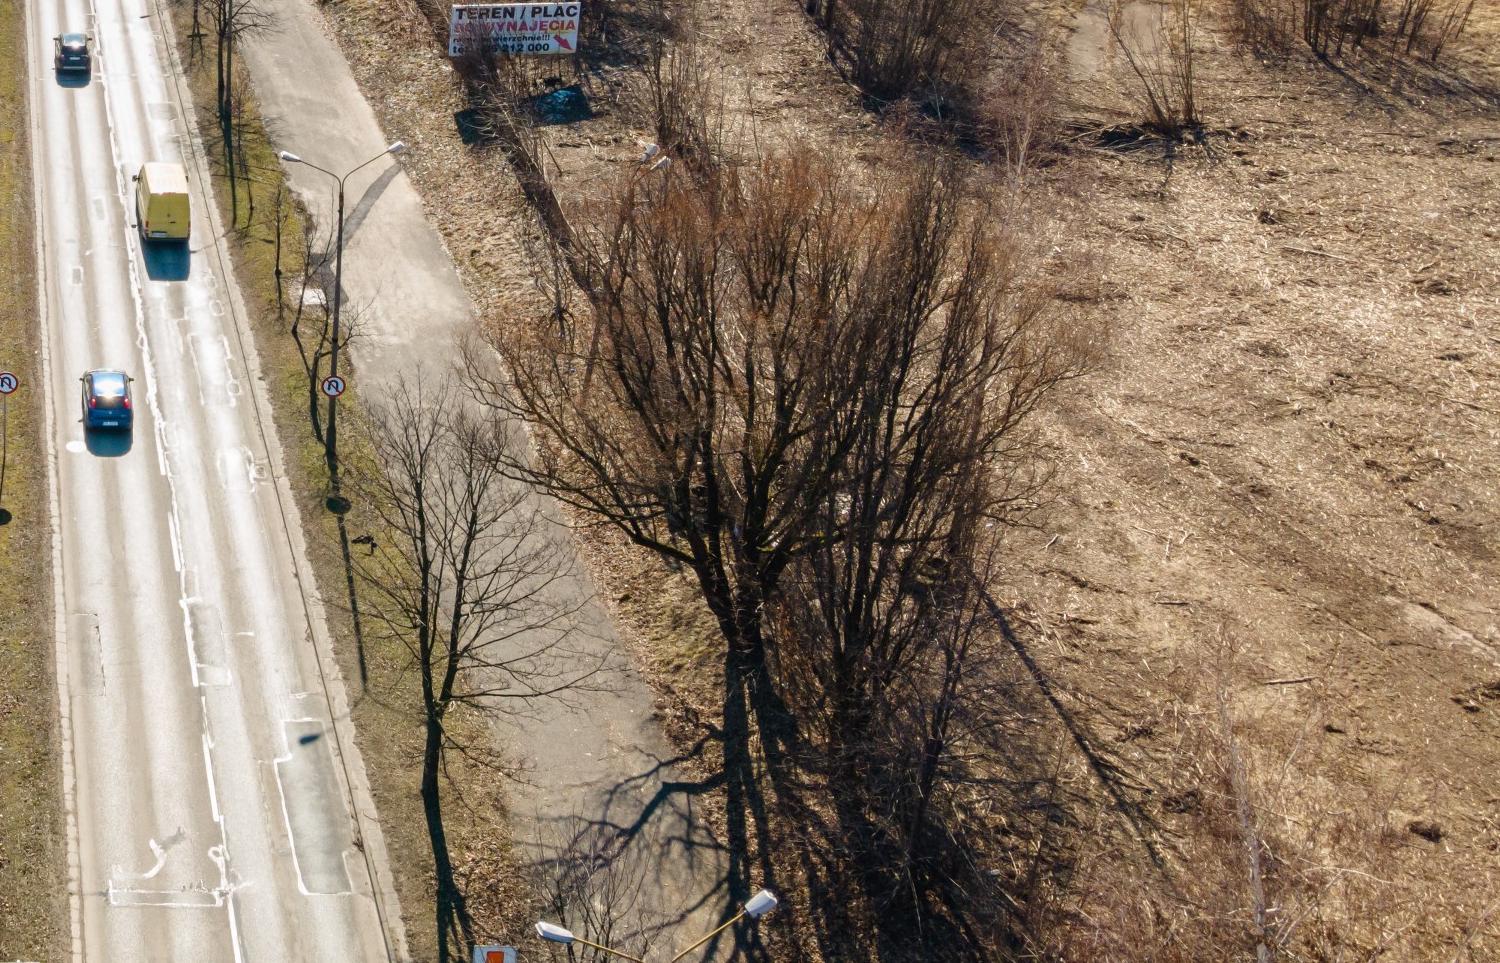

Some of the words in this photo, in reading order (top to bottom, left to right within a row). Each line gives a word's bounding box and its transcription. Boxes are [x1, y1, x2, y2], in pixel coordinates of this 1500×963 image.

[456, 7, 515, 20] TEREN
[520, 7, 526, 19] /
[531, 5, 578, 18] PLAC
[528, 43, 550, 51] 000
